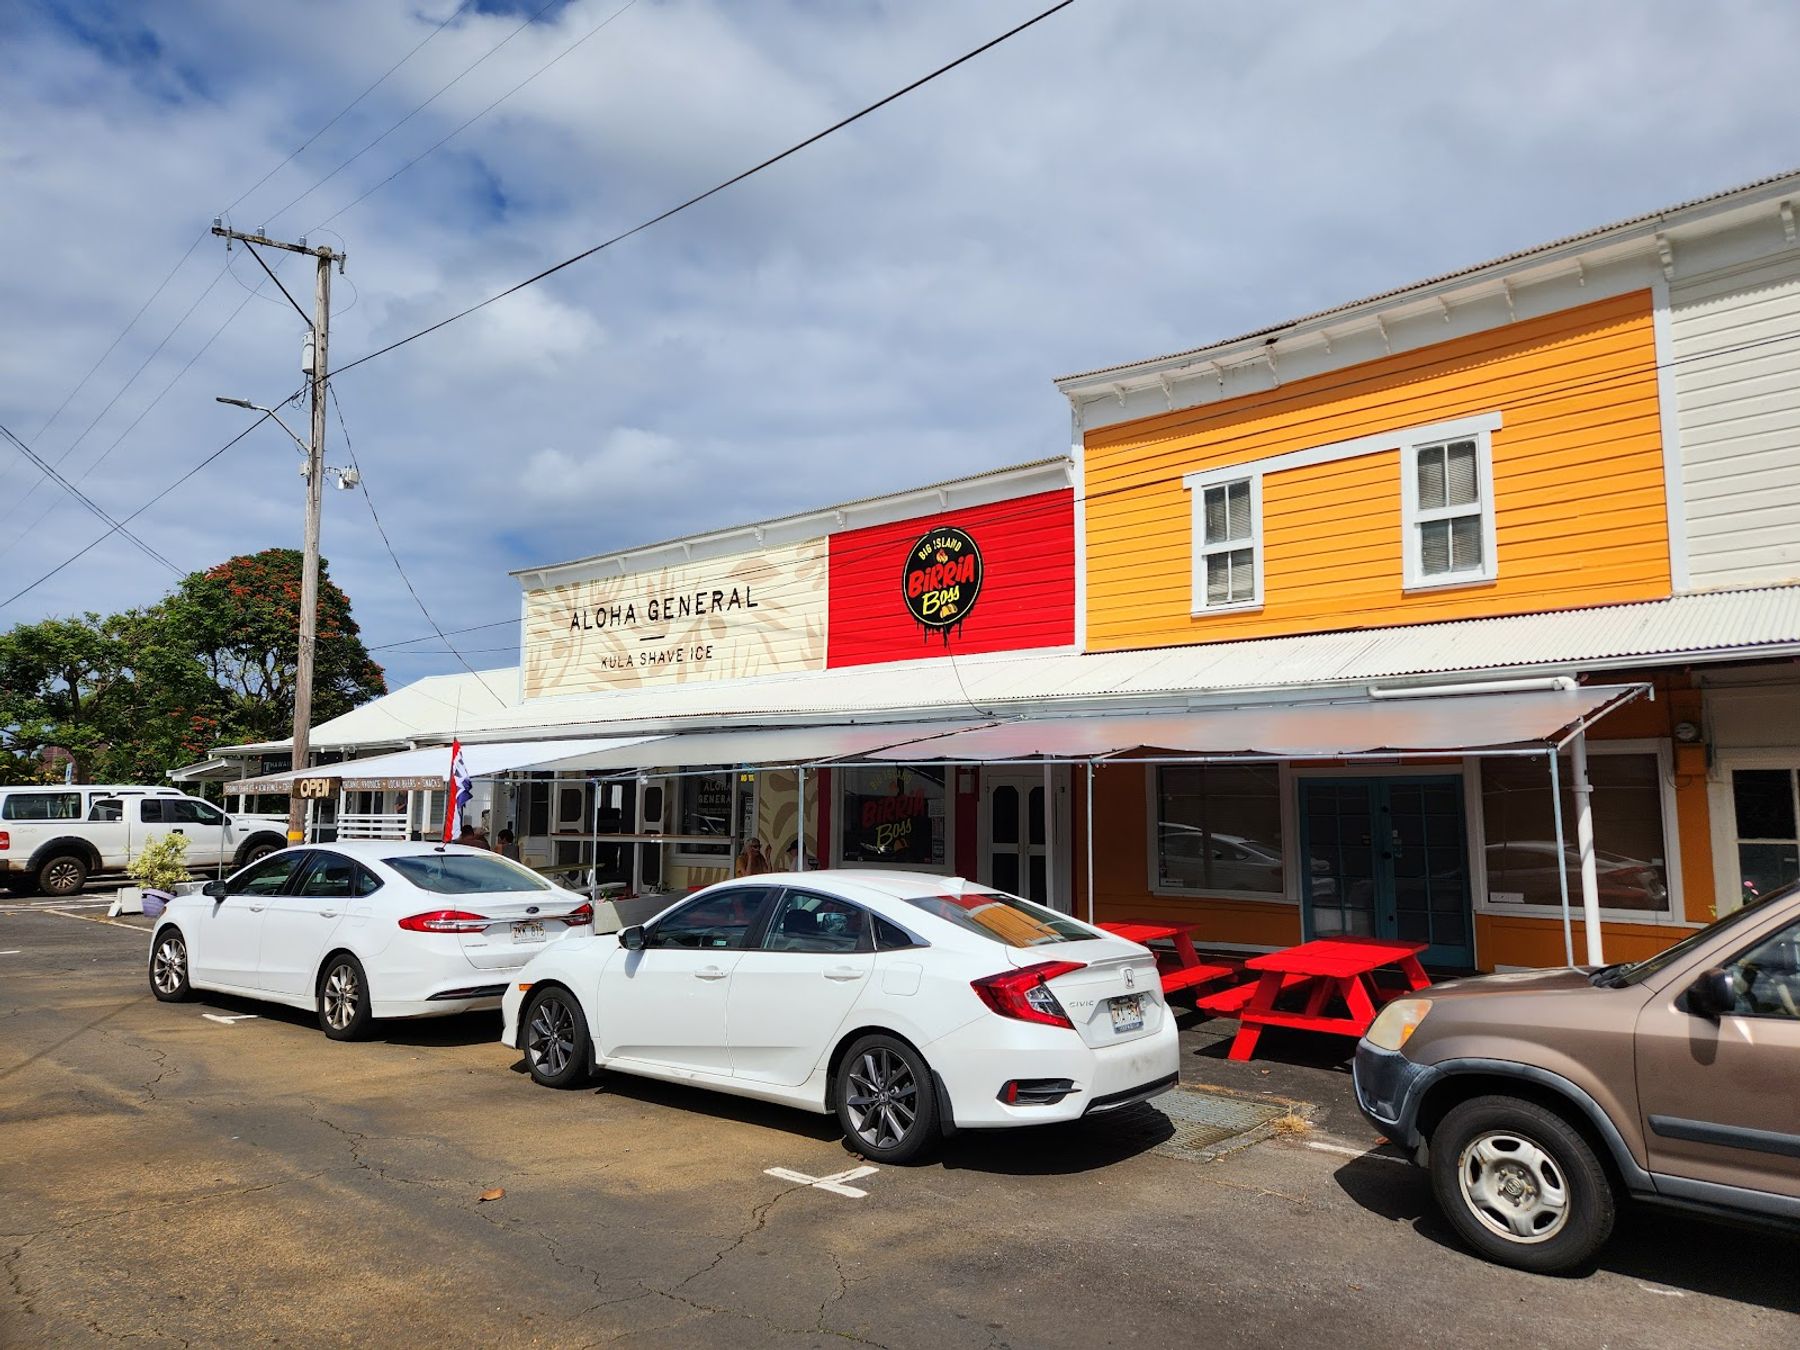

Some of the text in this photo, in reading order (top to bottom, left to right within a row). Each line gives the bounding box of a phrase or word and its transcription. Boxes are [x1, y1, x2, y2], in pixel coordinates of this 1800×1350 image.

[918, 537, 962, 561] BIG ISLAND
[570, 586, 759, 632] ALOHA GENERAL
[922, 585, 960, 616] Boss
[601, 645, 713, 669] KULA SHAVE ICE
[300, 778, 330, 798] OPEN
[698, 794, 731, 804] GENERA
[875, 818, 912, 848] Boss
